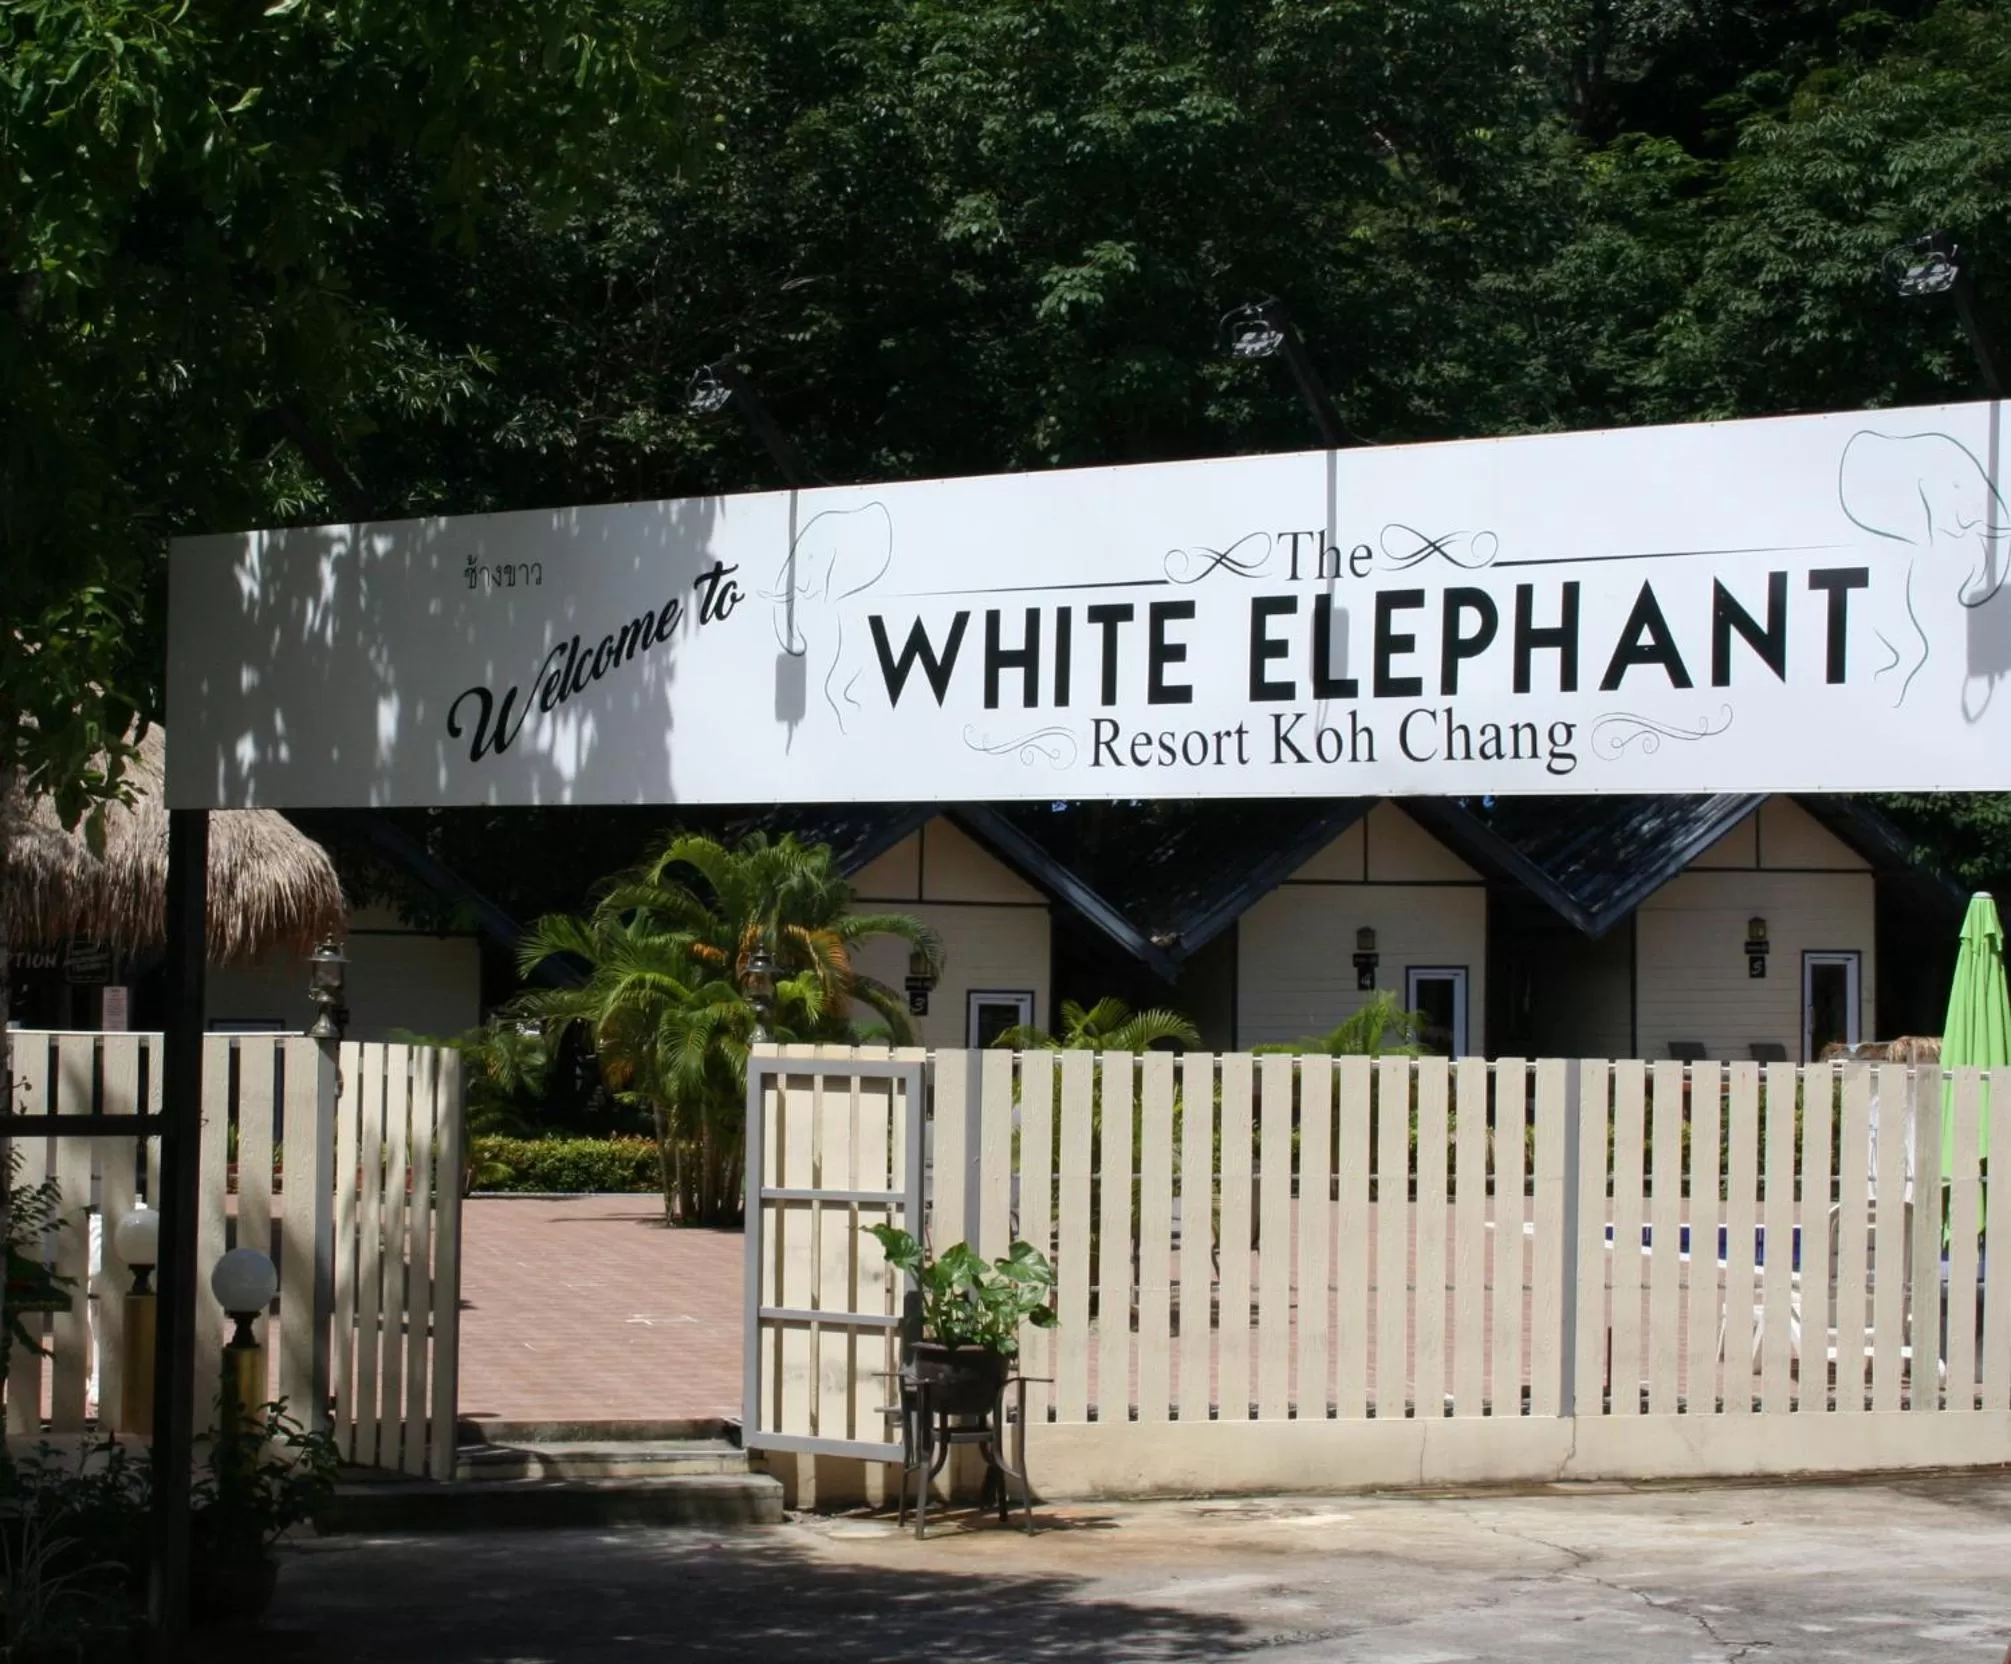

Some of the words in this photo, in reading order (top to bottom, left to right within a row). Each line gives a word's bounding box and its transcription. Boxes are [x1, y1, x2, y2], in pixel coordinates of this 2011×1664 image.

[463, 554, 543, 590] ช้างขาว
[1278, 528, 1374, 581] The
[446, 598, 684, 763] Welcome
[692, 560, 745, 626] to
[867, 600, 1196, 709] WHITE
[1248, 566, 1870, 702] ELEPHANT
[1089, 718, 1250, 768] Resort
[1270, 709, 1378, 765] Koh
[1398, 707, 1578, 776] Chang
